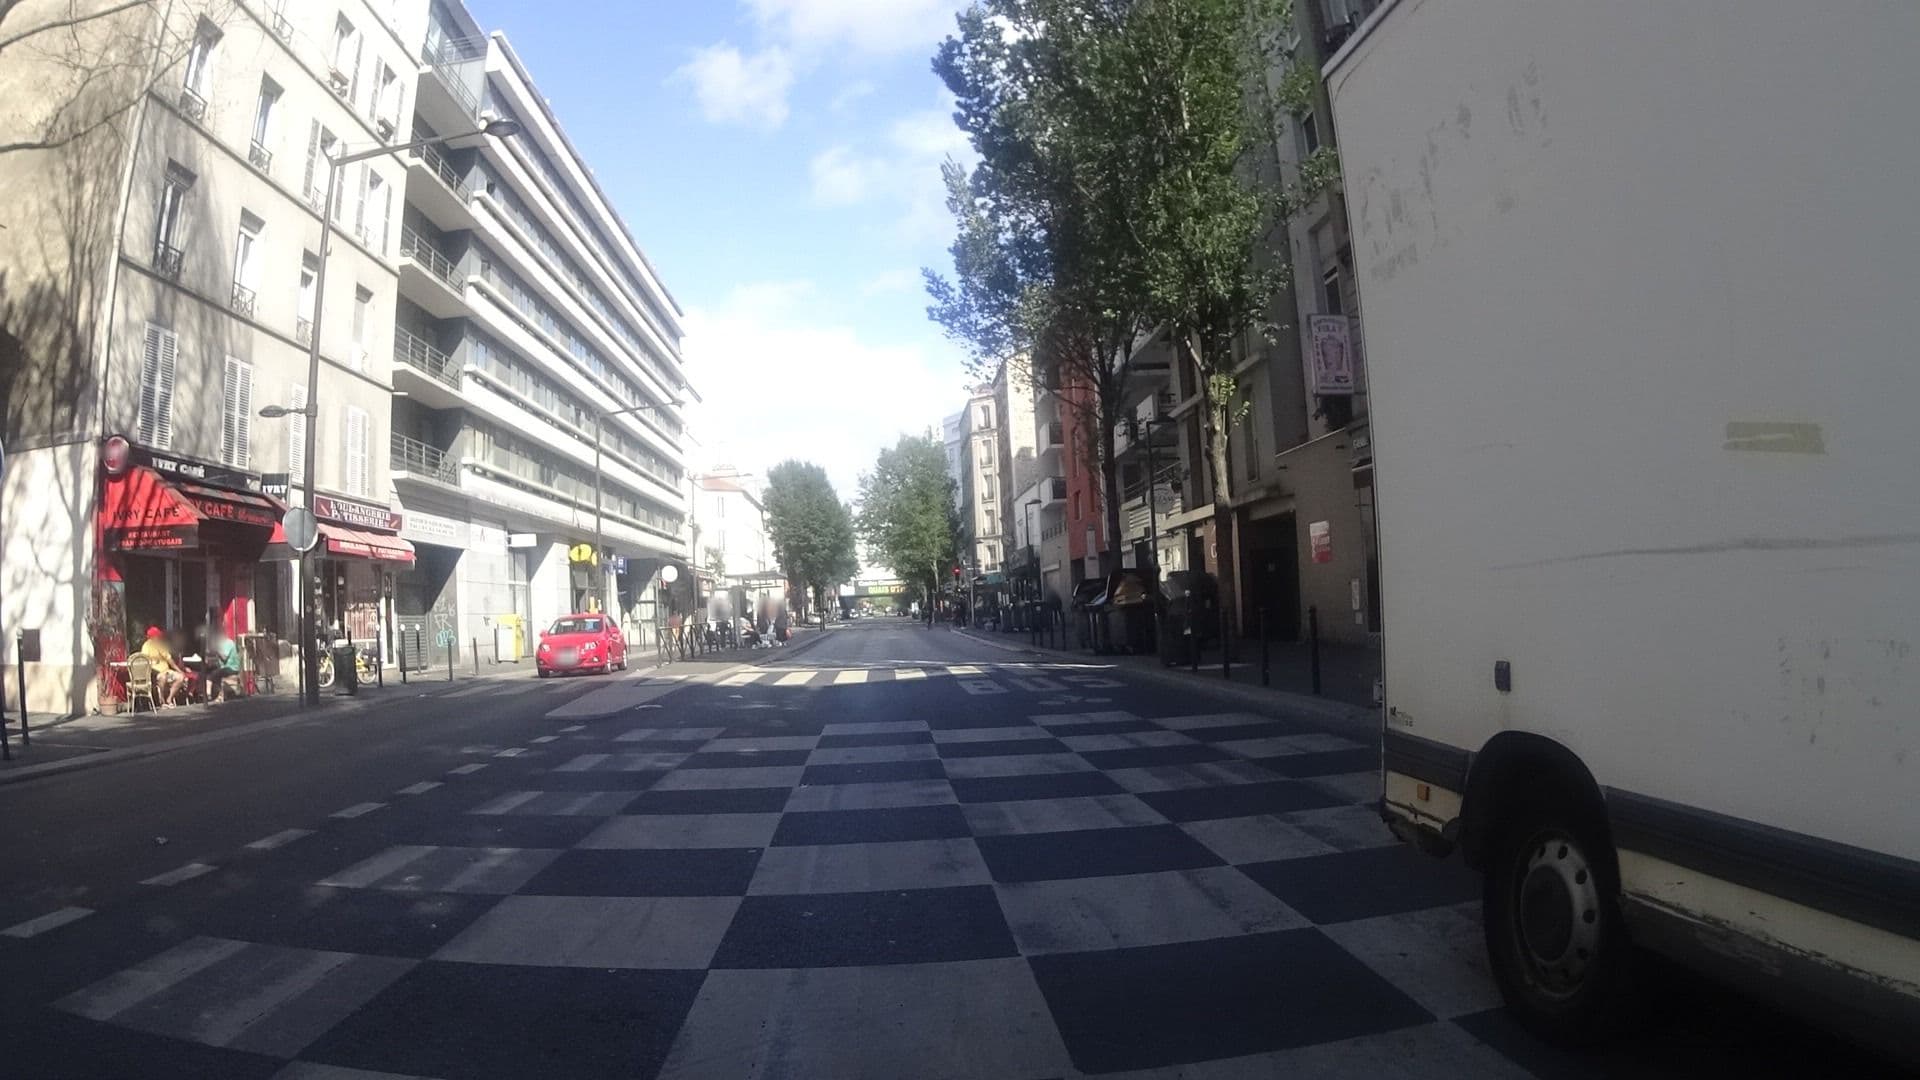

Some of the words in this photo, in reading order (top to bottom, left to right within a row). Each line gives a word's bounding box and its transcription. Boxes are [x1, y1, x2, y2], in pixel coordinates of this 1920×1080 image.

[152, 457, 178, 472] IVRY
[262, 484, 288, 494] IVRY
[330, 500, 391, 521] BOULANGERIE
